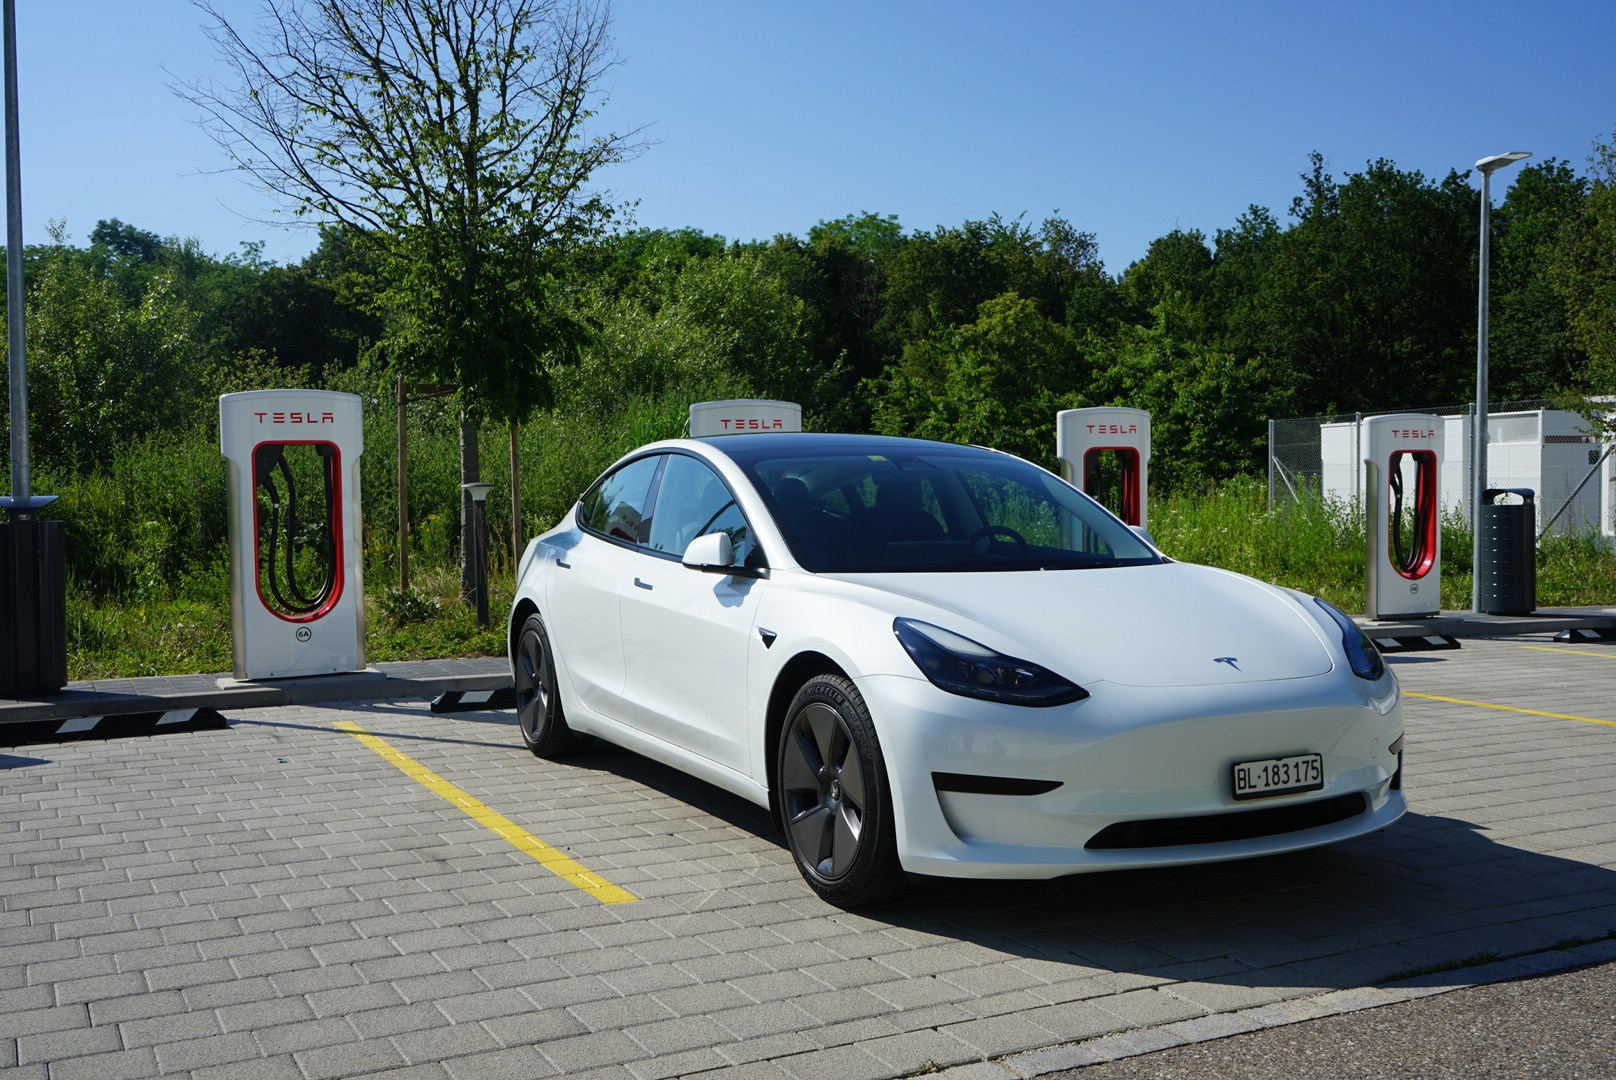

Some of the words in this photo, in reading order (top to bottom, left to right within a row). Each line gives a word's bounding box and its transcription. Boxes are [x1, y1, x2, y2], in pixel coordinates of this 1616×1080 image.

[254, 412, 334, 424] TESLA
[721, 419, 782, 429] TESLA
[1086, 425, 1137, 434] TESLA
[1392, 429, 1435, 439] TESLA
[806, 685, 844, 704] MICHELIN
